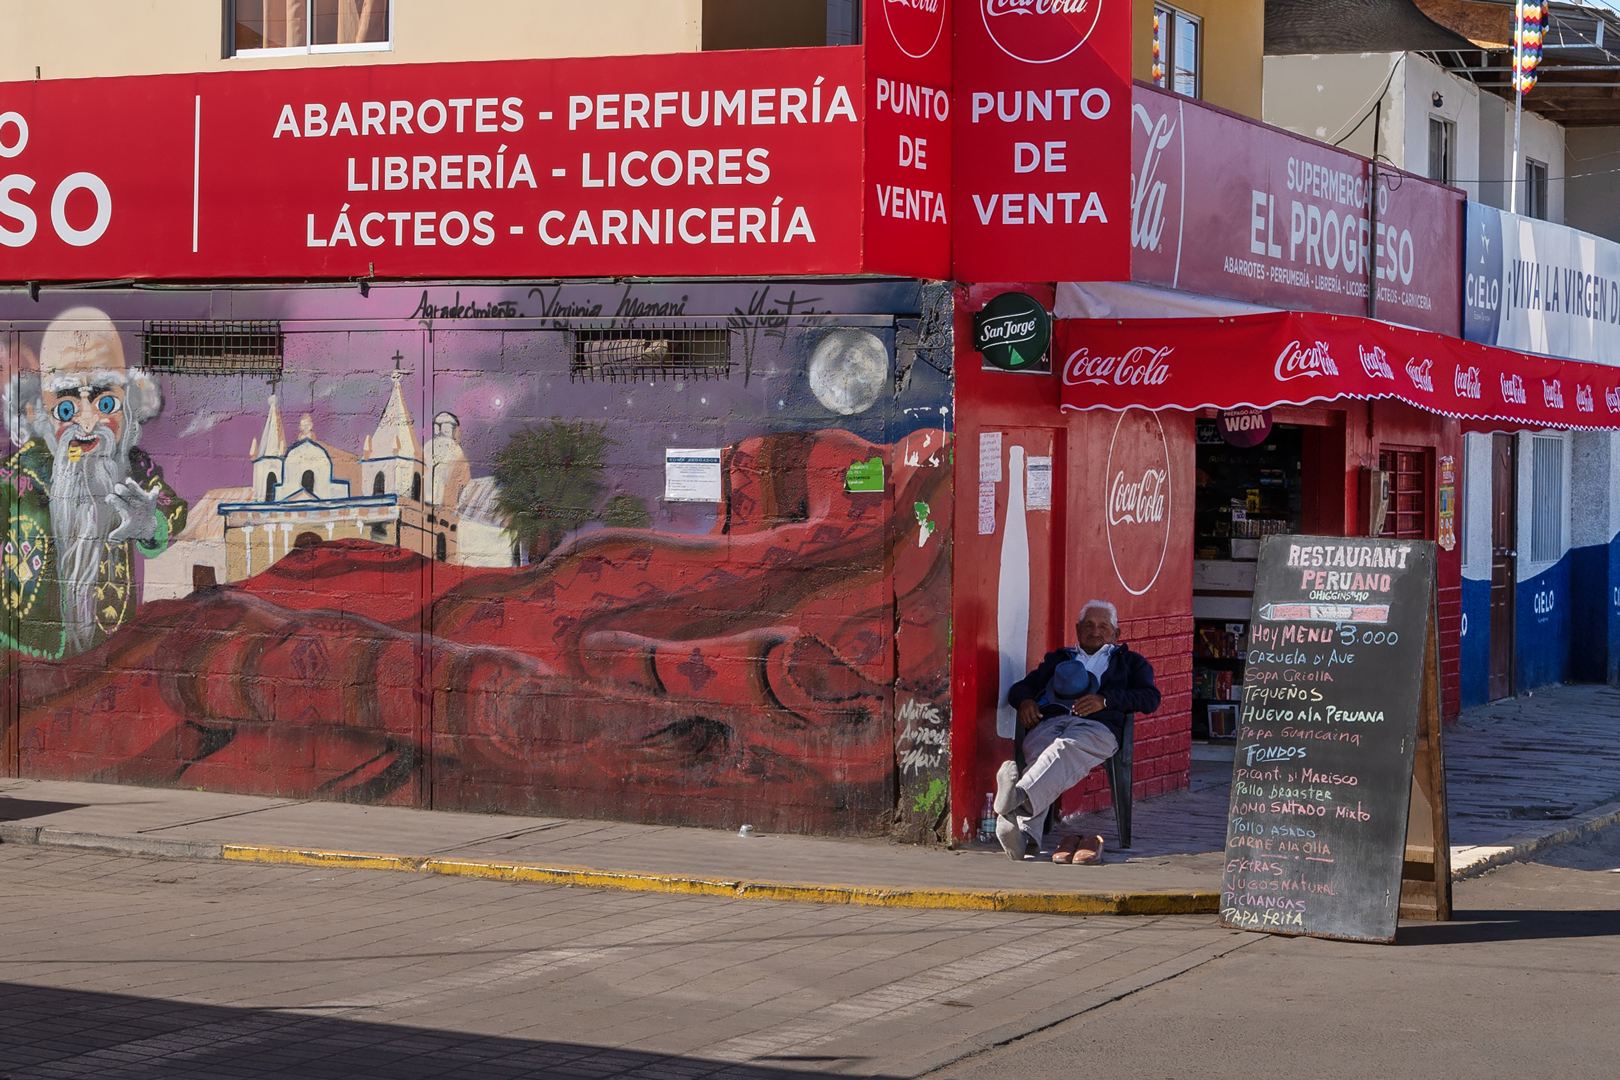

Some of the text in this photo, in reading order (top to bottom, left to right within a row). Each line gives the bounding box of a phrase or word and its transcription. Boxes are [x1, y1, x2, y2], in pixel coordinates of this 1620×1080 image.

[273, 96, 525, 139] ABARROTES
[568, 75, 858, 131] PERFUMERÍA
[876, 77, 949, 122] PUNTO
[972, 87, 1111, 123] PUNTO
[346, 143, 538, 192] LIBRERÍA
[581, 148, 770, 189] LICORES
[899, 135, 927, 170] DE
[1014, 141, 1067, 173] DE
[1287, 156, 1388, 216] SUPERMERCAO
[876, 184, 947, 225] VENTA
[972, 192, 1108, 225] VENTA
[306, 203, 496, 249] LÁCTEOS
[538, 196, 816, 247] CARNICERÍA
[1250, 189, 1282, 259] EL
[1223, 256, 1265, 281] ABARROTES
[1270, 267, 1310, 289] PERFUMERÍA
[1314, 275, 1342, 294] LIBRERÍA
[1376, 283, 1398, 304] ÁCTEOS
[1401, 291, 1432, 310] CARNICERÍA
[1465, 273, 1499, 311] CIELO
[1545, 264, 1560, 313] LA
[1564, 267, 1608, 323] VIRGEN
[980, 319, 1037, 342] San Jorge
[1062, 346, 1175, 386] Coca-Cola
[1224, 414, 1266, 432] WOM
[1109, 469, 1167, 526] Coca-Cola
[1287, 544, 1411, 569] RESTAURANT
[1301, 570, 1391, 592] PERUANO
[1533, 590, 1555, 614] CIELO
[1280, 624, 1333, 647] MENU
[1241, 705, 1294, 724] HUEVO
[1326, 705, 1385, 724] PERUANA
[1242, 744, 1307, 767] FONDOS
[1271, 825, 1316, 838] ASADO
[1221, 907, 1259, 927] PAPA
